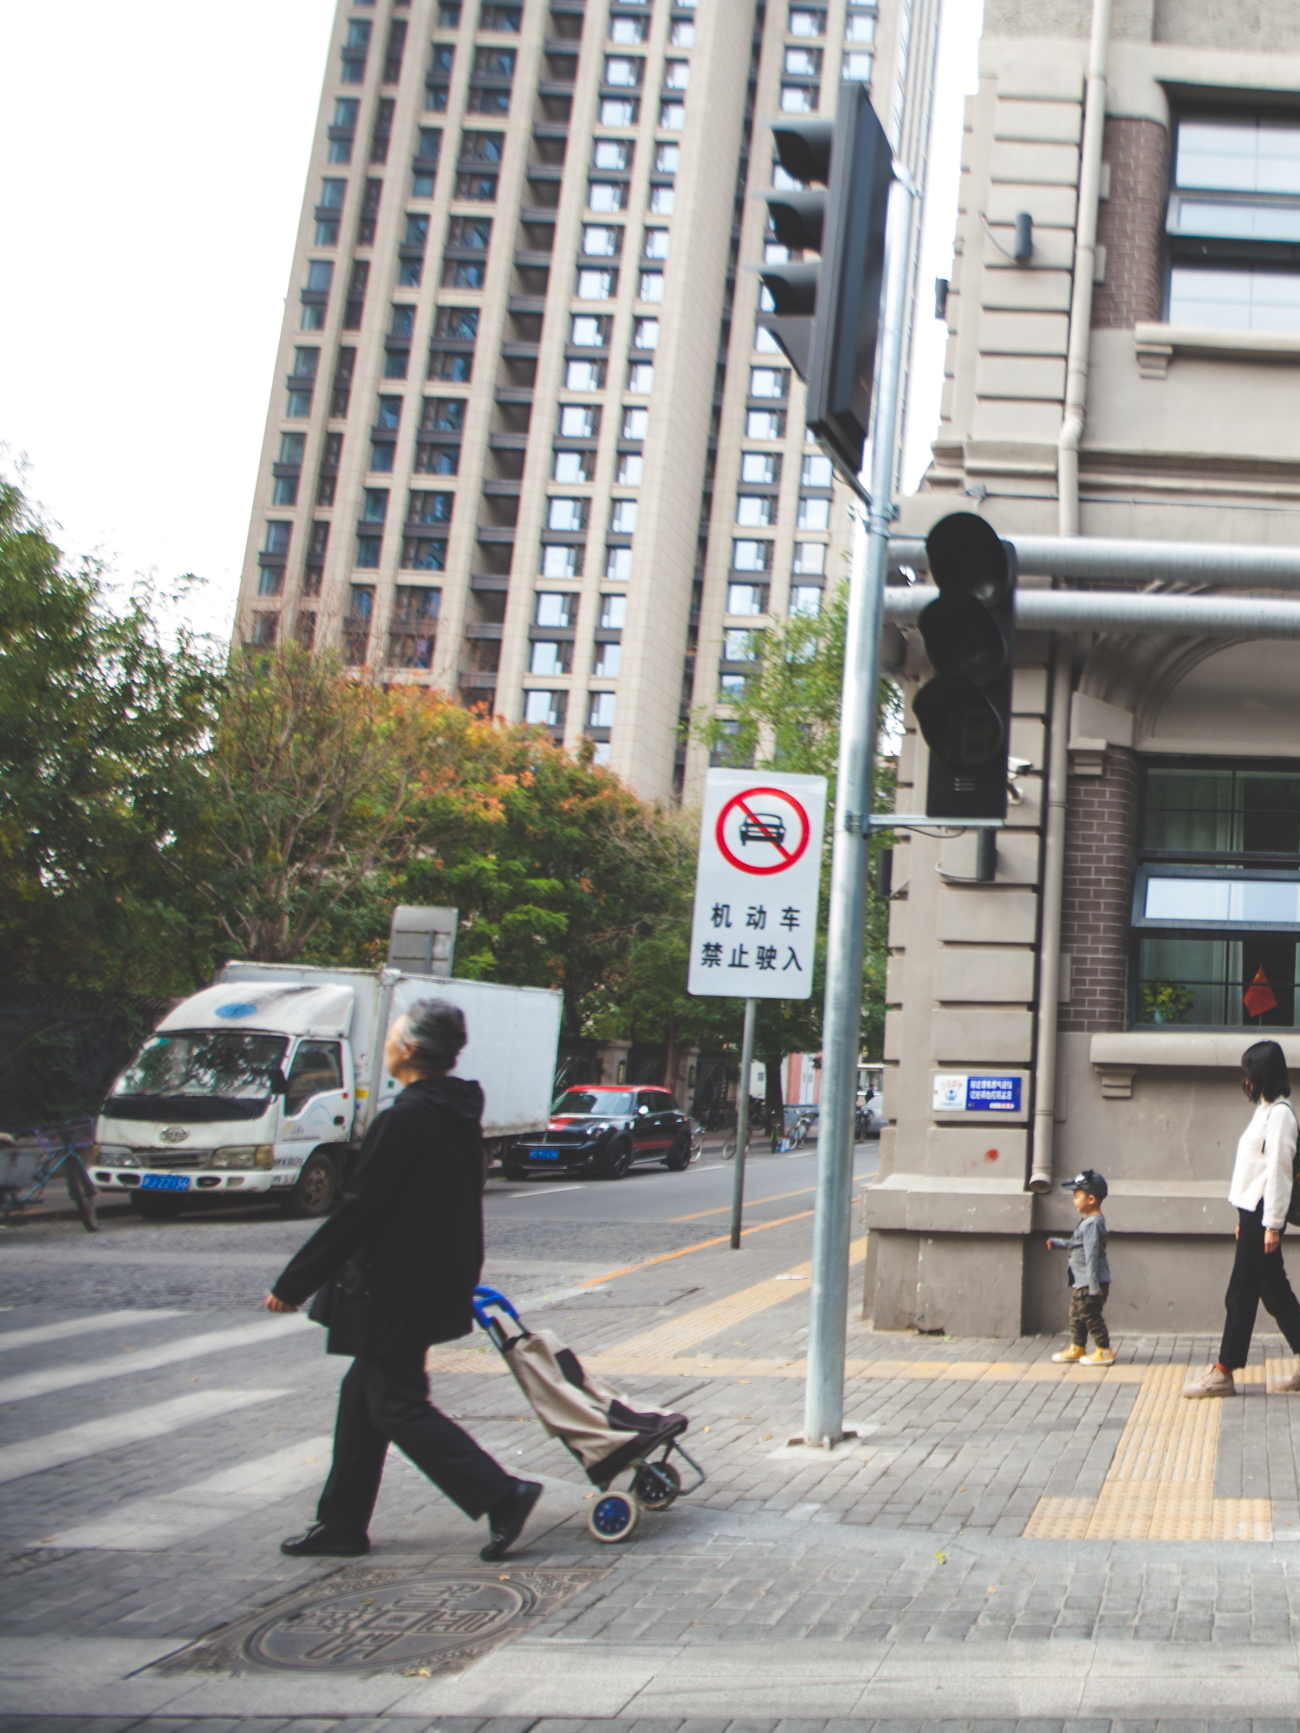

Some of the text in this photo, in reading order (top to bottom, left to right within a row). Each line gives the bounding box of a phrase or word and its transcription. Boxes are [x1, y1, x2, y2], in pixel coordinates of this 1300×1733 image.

[710, 902, 801, 932] 机动车
[700, 941, 803, 972] 禁止驶入
